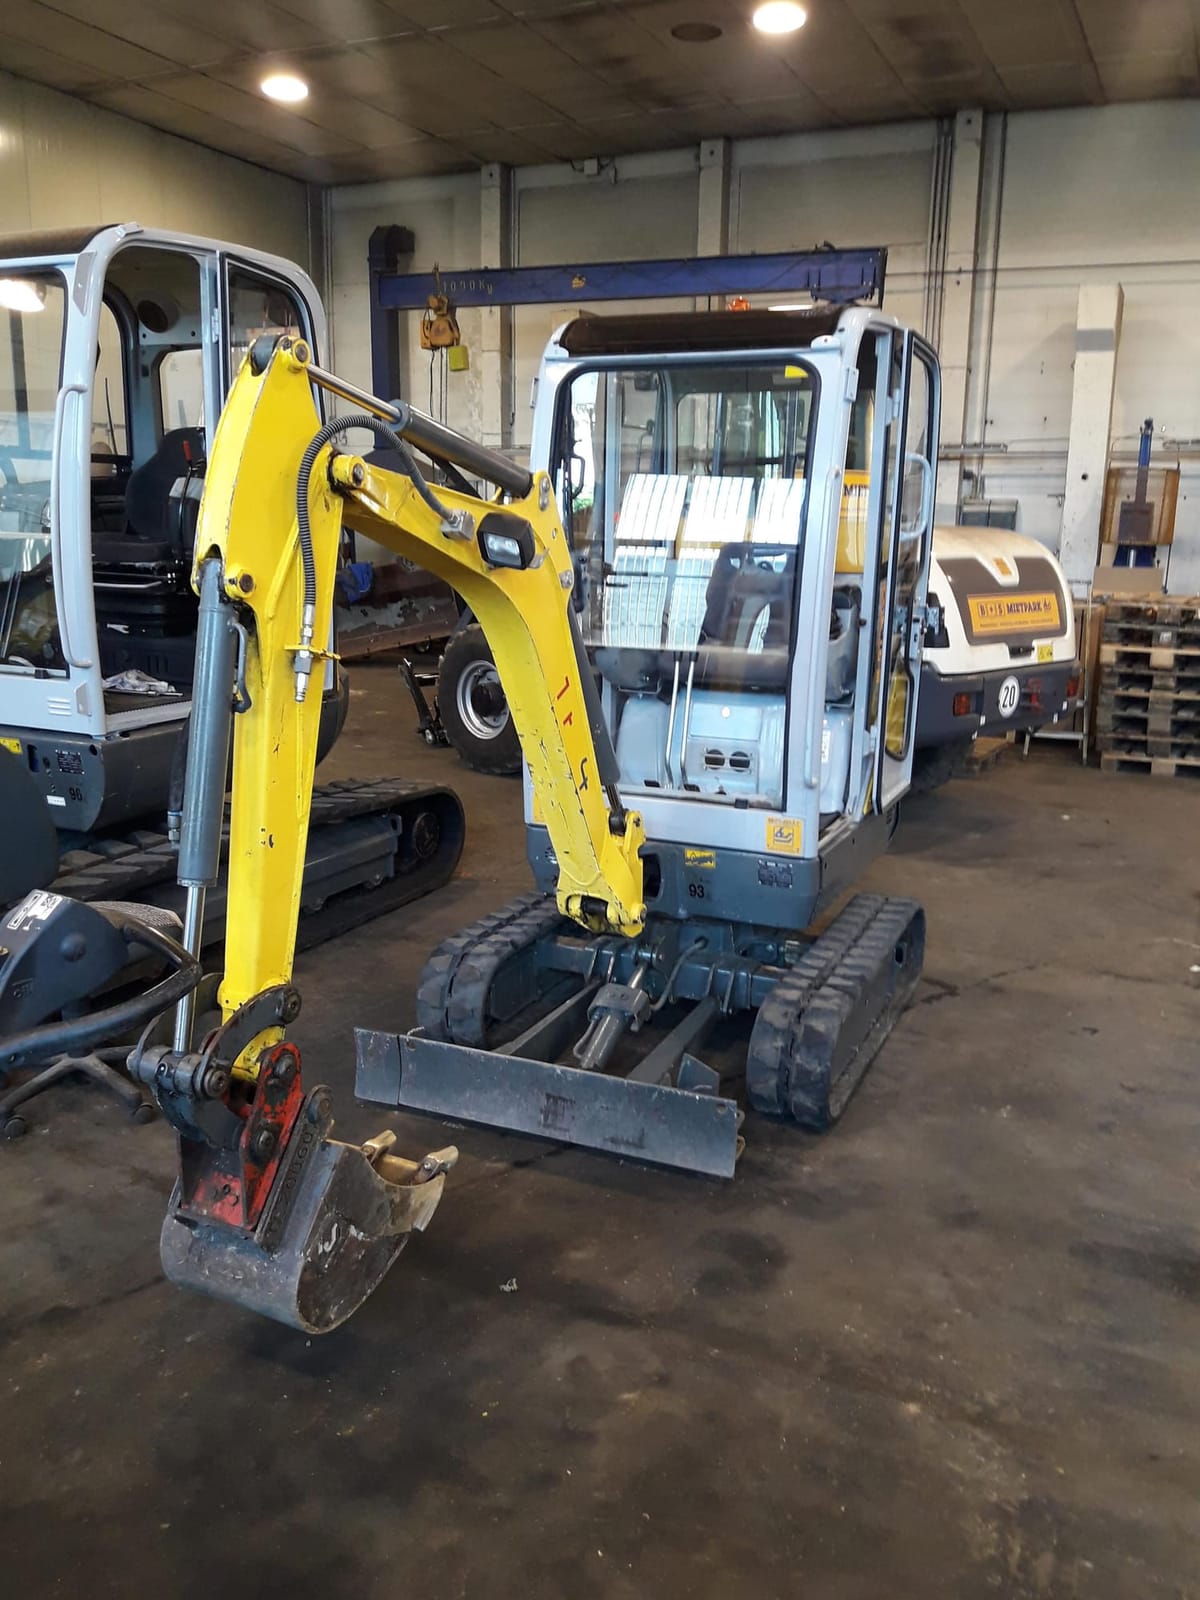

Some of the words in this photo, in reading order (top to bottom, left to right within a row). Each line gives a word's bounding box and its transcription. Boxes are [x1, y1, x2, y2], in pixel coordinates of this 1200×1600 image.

[1006, 600, 1042, 614] MIETPARK
[1002, 685, 1016, 708] 20
[688, 883, 705, 898] 93
